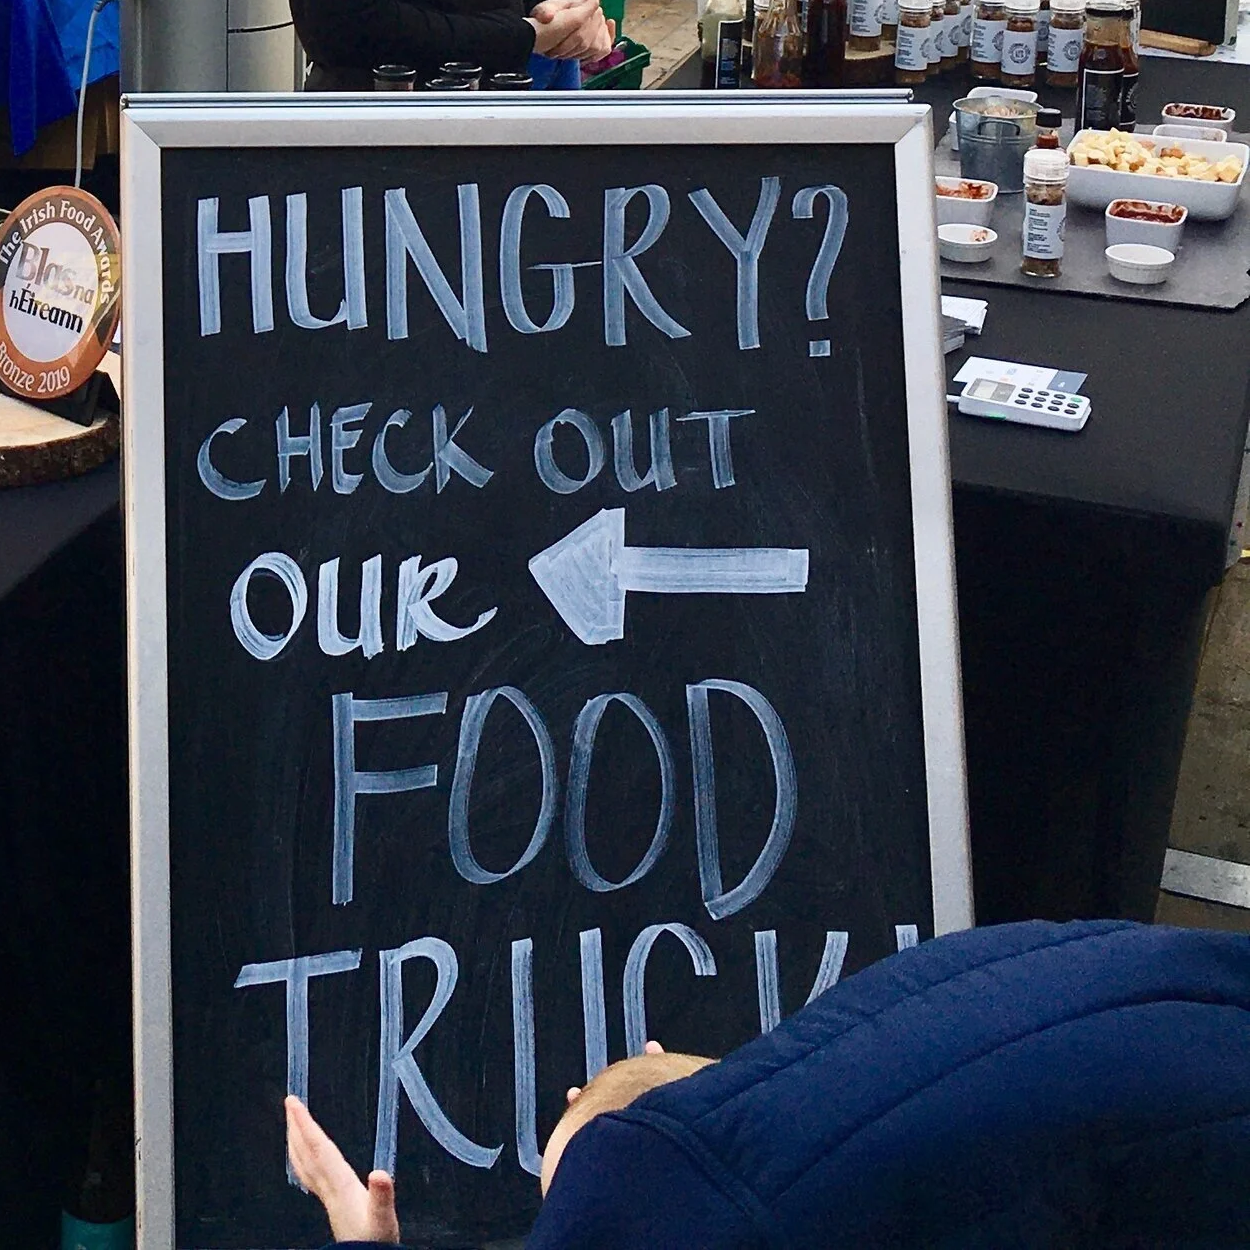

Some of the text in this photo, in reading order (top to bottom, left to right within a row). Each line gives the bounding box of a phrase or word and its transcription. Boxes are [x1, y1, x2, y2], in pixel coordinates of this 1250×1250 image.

[15, 240, 95, 306] Blas na
[19, 199, 57, 235] Irish
[59, 199, 97, 233] Food
[90, 226, 116, 306] Awards
[196, 177, 850, 358] HUNGRY?
[8, 281, 85, 335] hÉireann
[37, 365, 71, 393] 2019
[196, 400, 757, 502] CHECK OUT
[229, 550, 499, 661] OUR
[331, 677, 799, 922] FOOD
